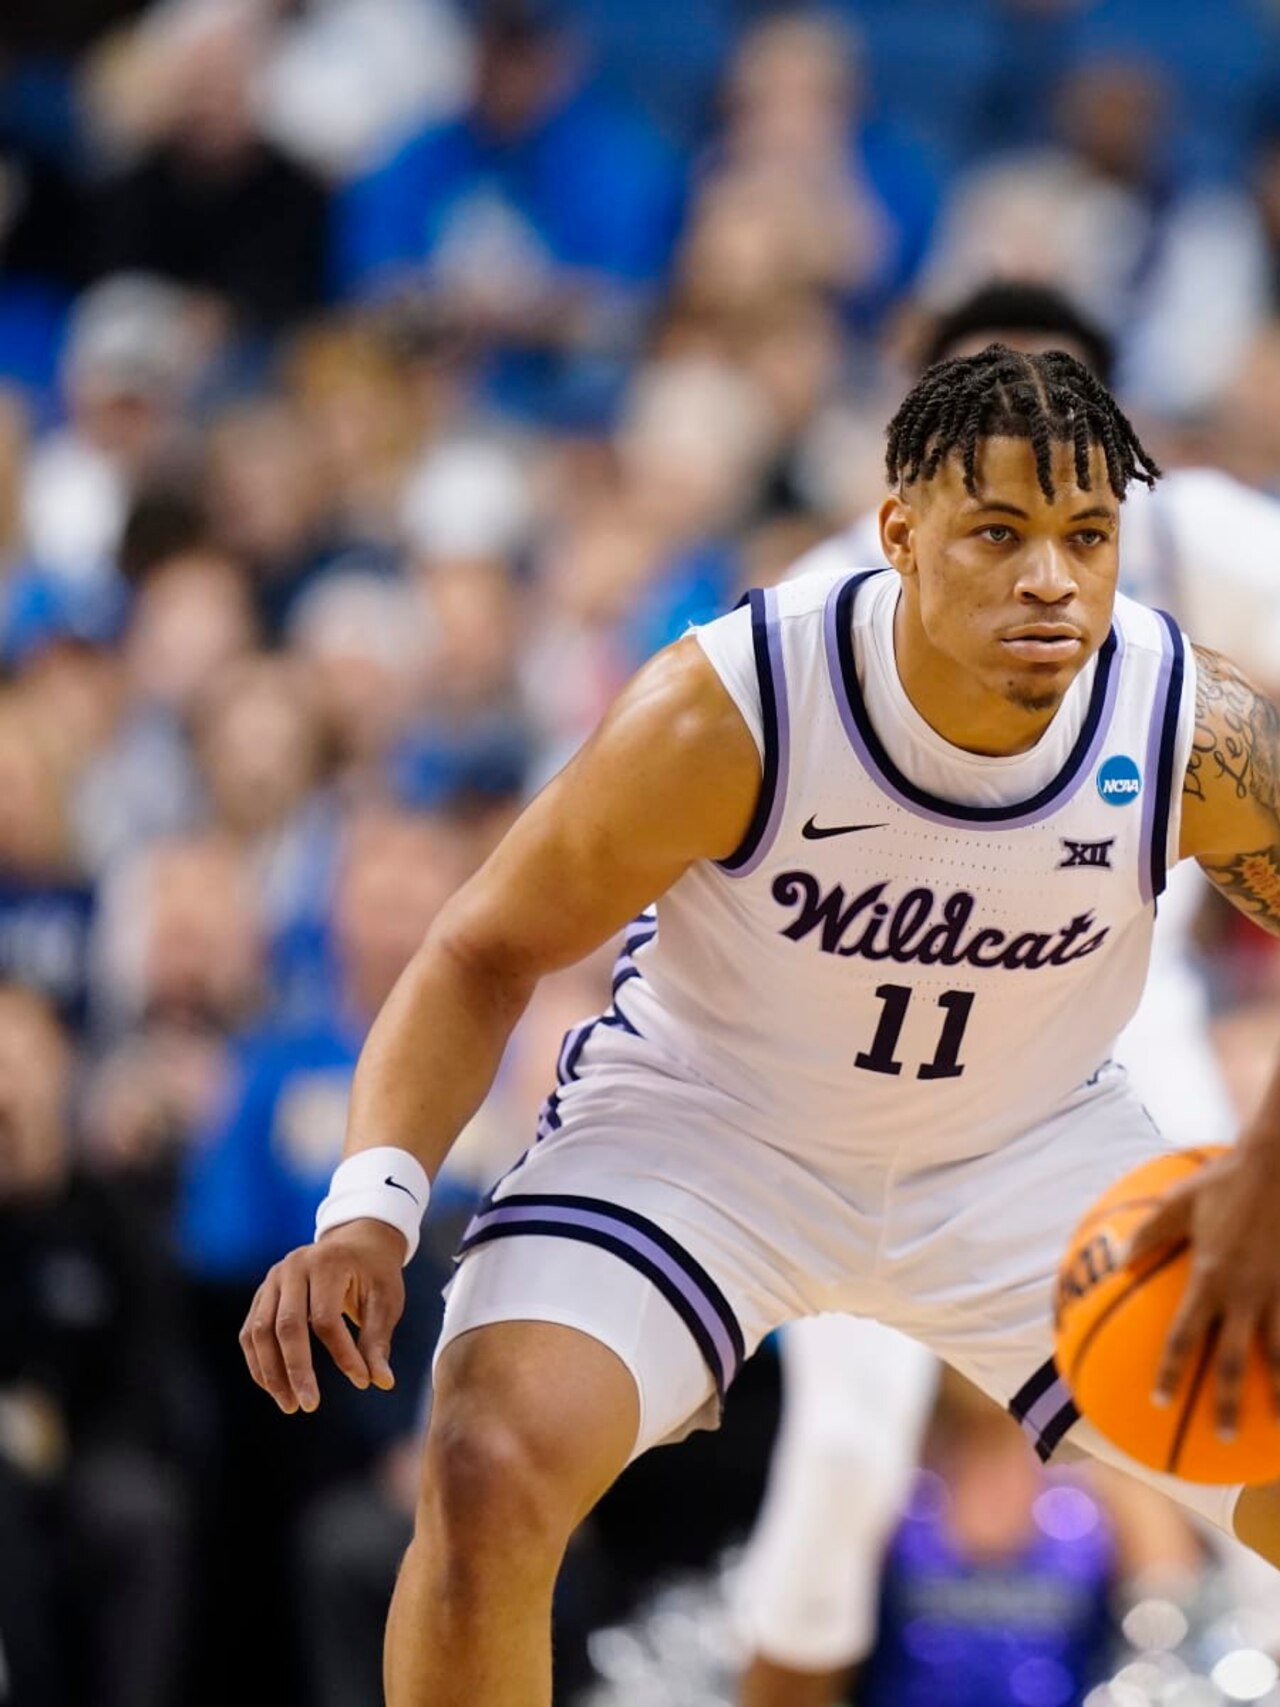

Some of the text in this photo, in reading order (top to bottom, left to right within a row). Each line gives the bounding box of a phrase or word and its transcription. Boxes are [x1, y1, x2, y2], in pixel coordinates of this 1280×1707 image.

[1103, 778, 1139, 794] NCAA
[1059, 838, 1115, 869] XII
[771, 869, 1110, 971] Wildcats
[853, 983, 976, 1080] 11
